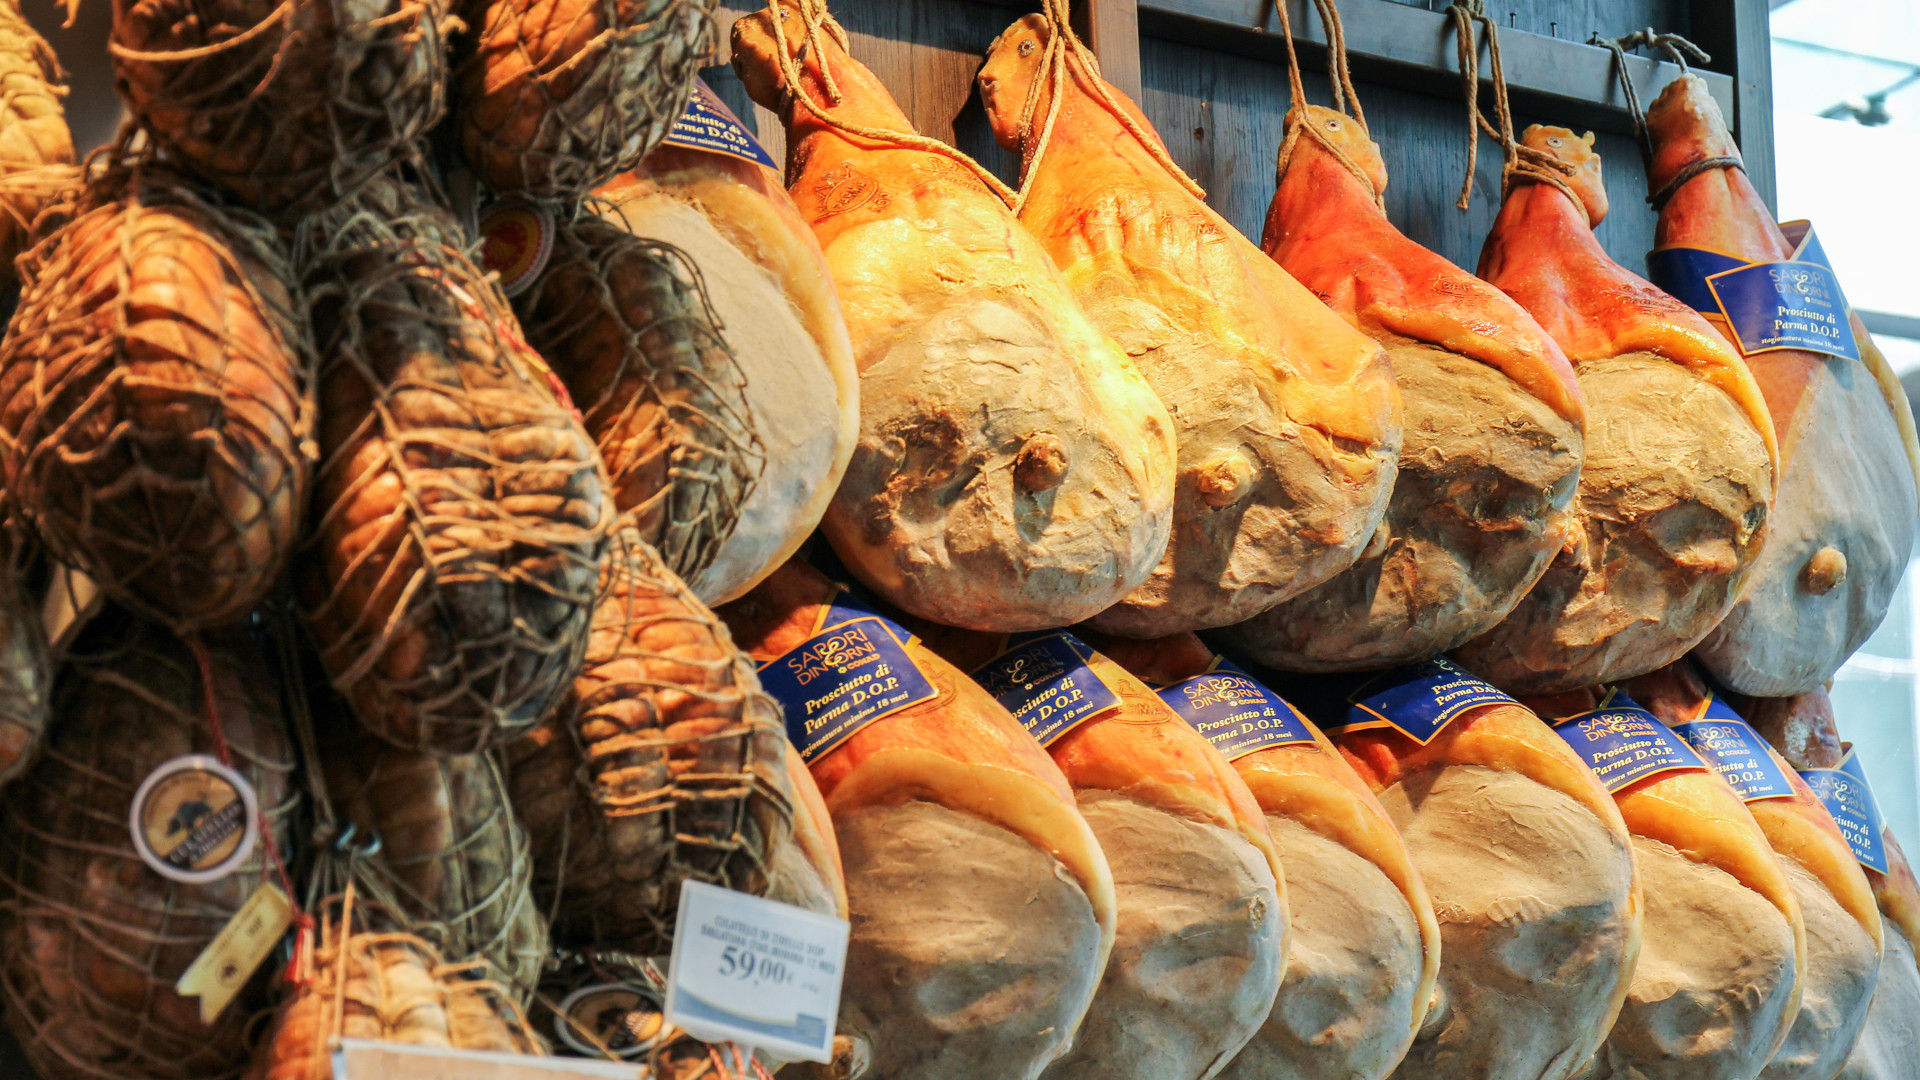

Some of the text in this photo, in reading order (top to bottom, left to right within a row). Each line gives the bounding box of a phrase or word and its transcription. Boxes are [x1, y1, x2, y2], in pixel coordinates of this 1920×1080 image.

[672, 123, 750, 147] arma D.O.P.
[680, 113, 742, 135] osciutto di
[1777, 305, 1836, 324] Prosciutto di
[1761, 336, 1802, 344] stagionatura
[1774, 319, 1840, 339] Parma D.O.P.
[804, 664, 890, 715] Prosciutto di
[993, 659, 1064, 701] DINORNI
[1431, 679, 1484, 695] Prosciutto
[803, 676, 899, 735] Parma D.O.P.
[1011, 676, 1076, 719] osciutto di
[1039, 688, 1084, 721] D.O.P.
[1435, 687, 1474, 706] Parma
[1063, 711, 1076, 722] 18
[1076, 700, 1094, 714] mesi
[1196, 706, 1276, 734] Prosciutto di
[1432, 699, 1472, 726] stagionatura
[801, 691, 909, 758] agionatura minima 18 mesi
[1207, 718, 1284, 744] arma D.O.P.
[1231, 737, 1262, 751] minima
[1263, 732, 1275, 741] 18
[1592, 737, 1667, 763] Prosciutto di
[1694, 738, 1747, 753] INORNI
[1592, 747, 1675, 776] Parma D.O.P.
[1626, 762, 1656, 776] minima
[1656, 758, 1668, 766] 18
[1714, 758, 1758, 774] ciutto di
[1728, 771, 1766, 785] D.O.P.
[1748, 785, 1758, 794] 18
[1833, 815, 1869, 836] ciutto di
[1843, 829, 1871, 850] D.O.P.
